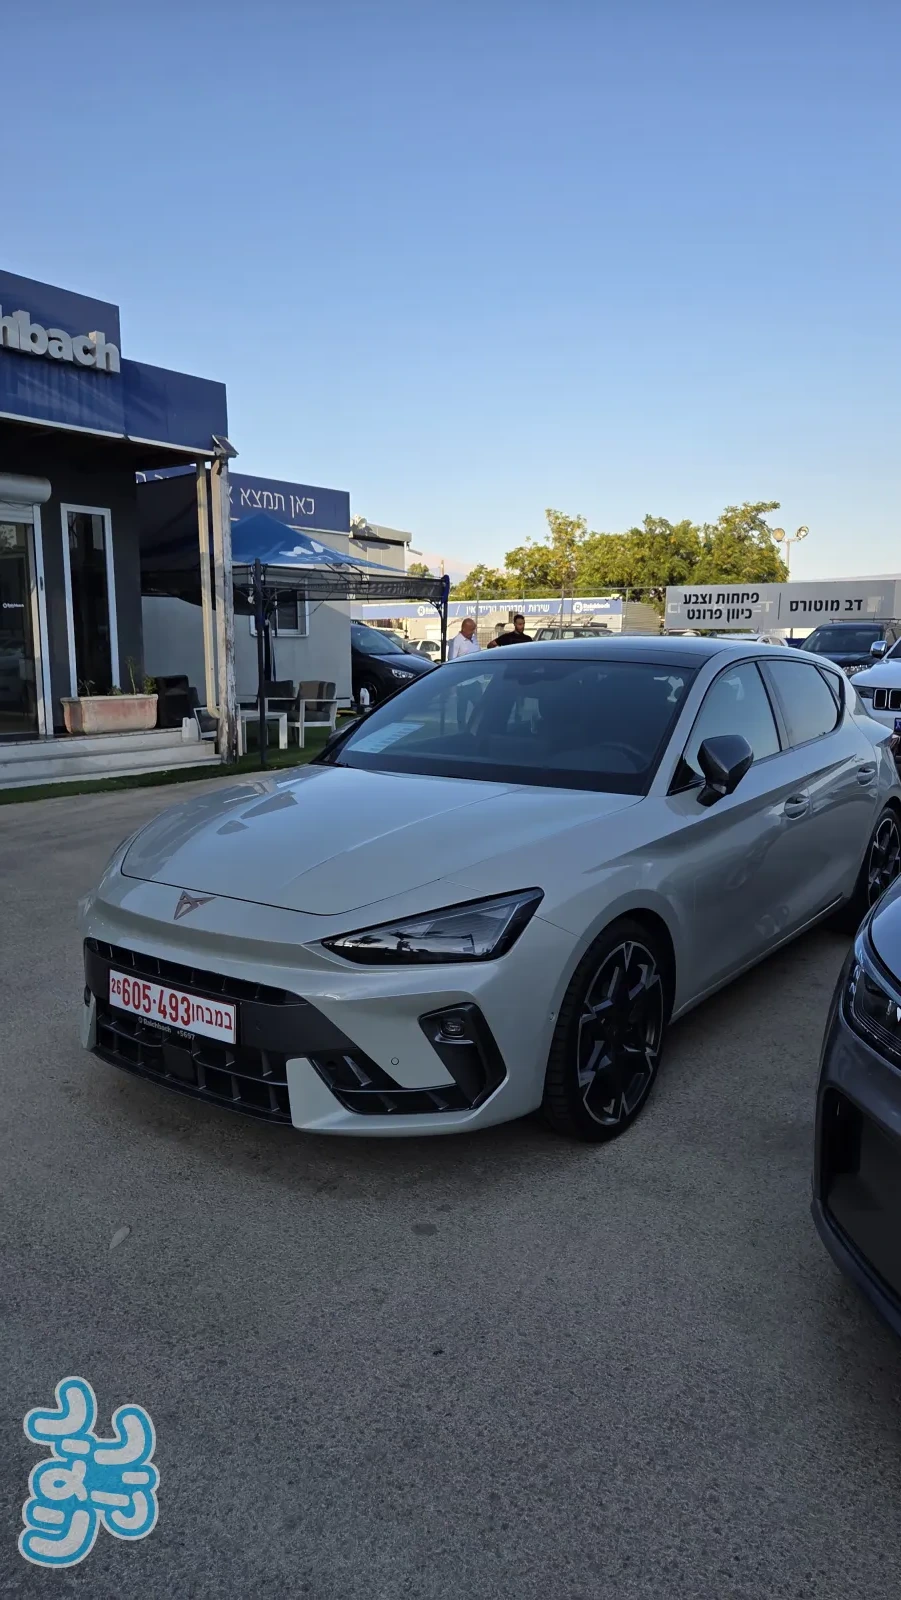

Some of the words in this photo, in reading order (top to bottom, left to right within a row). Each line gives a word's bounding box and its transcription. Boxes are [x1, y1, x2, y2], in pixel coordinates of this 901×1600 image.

[239, 487, 285, 512] תמצא
[289, 494, 315, 518] כאן
[683, 593, 712, 605] וצבע
[844, 599, 863, 611] דב
[527, 604, 550, 613] שירות
[687, 607, 723, 620] פרונט
[726, 607, 753, 623] כיוון
[111, 977, 121, 995] 26
[191, 1003, 233, 1030] במבחן
